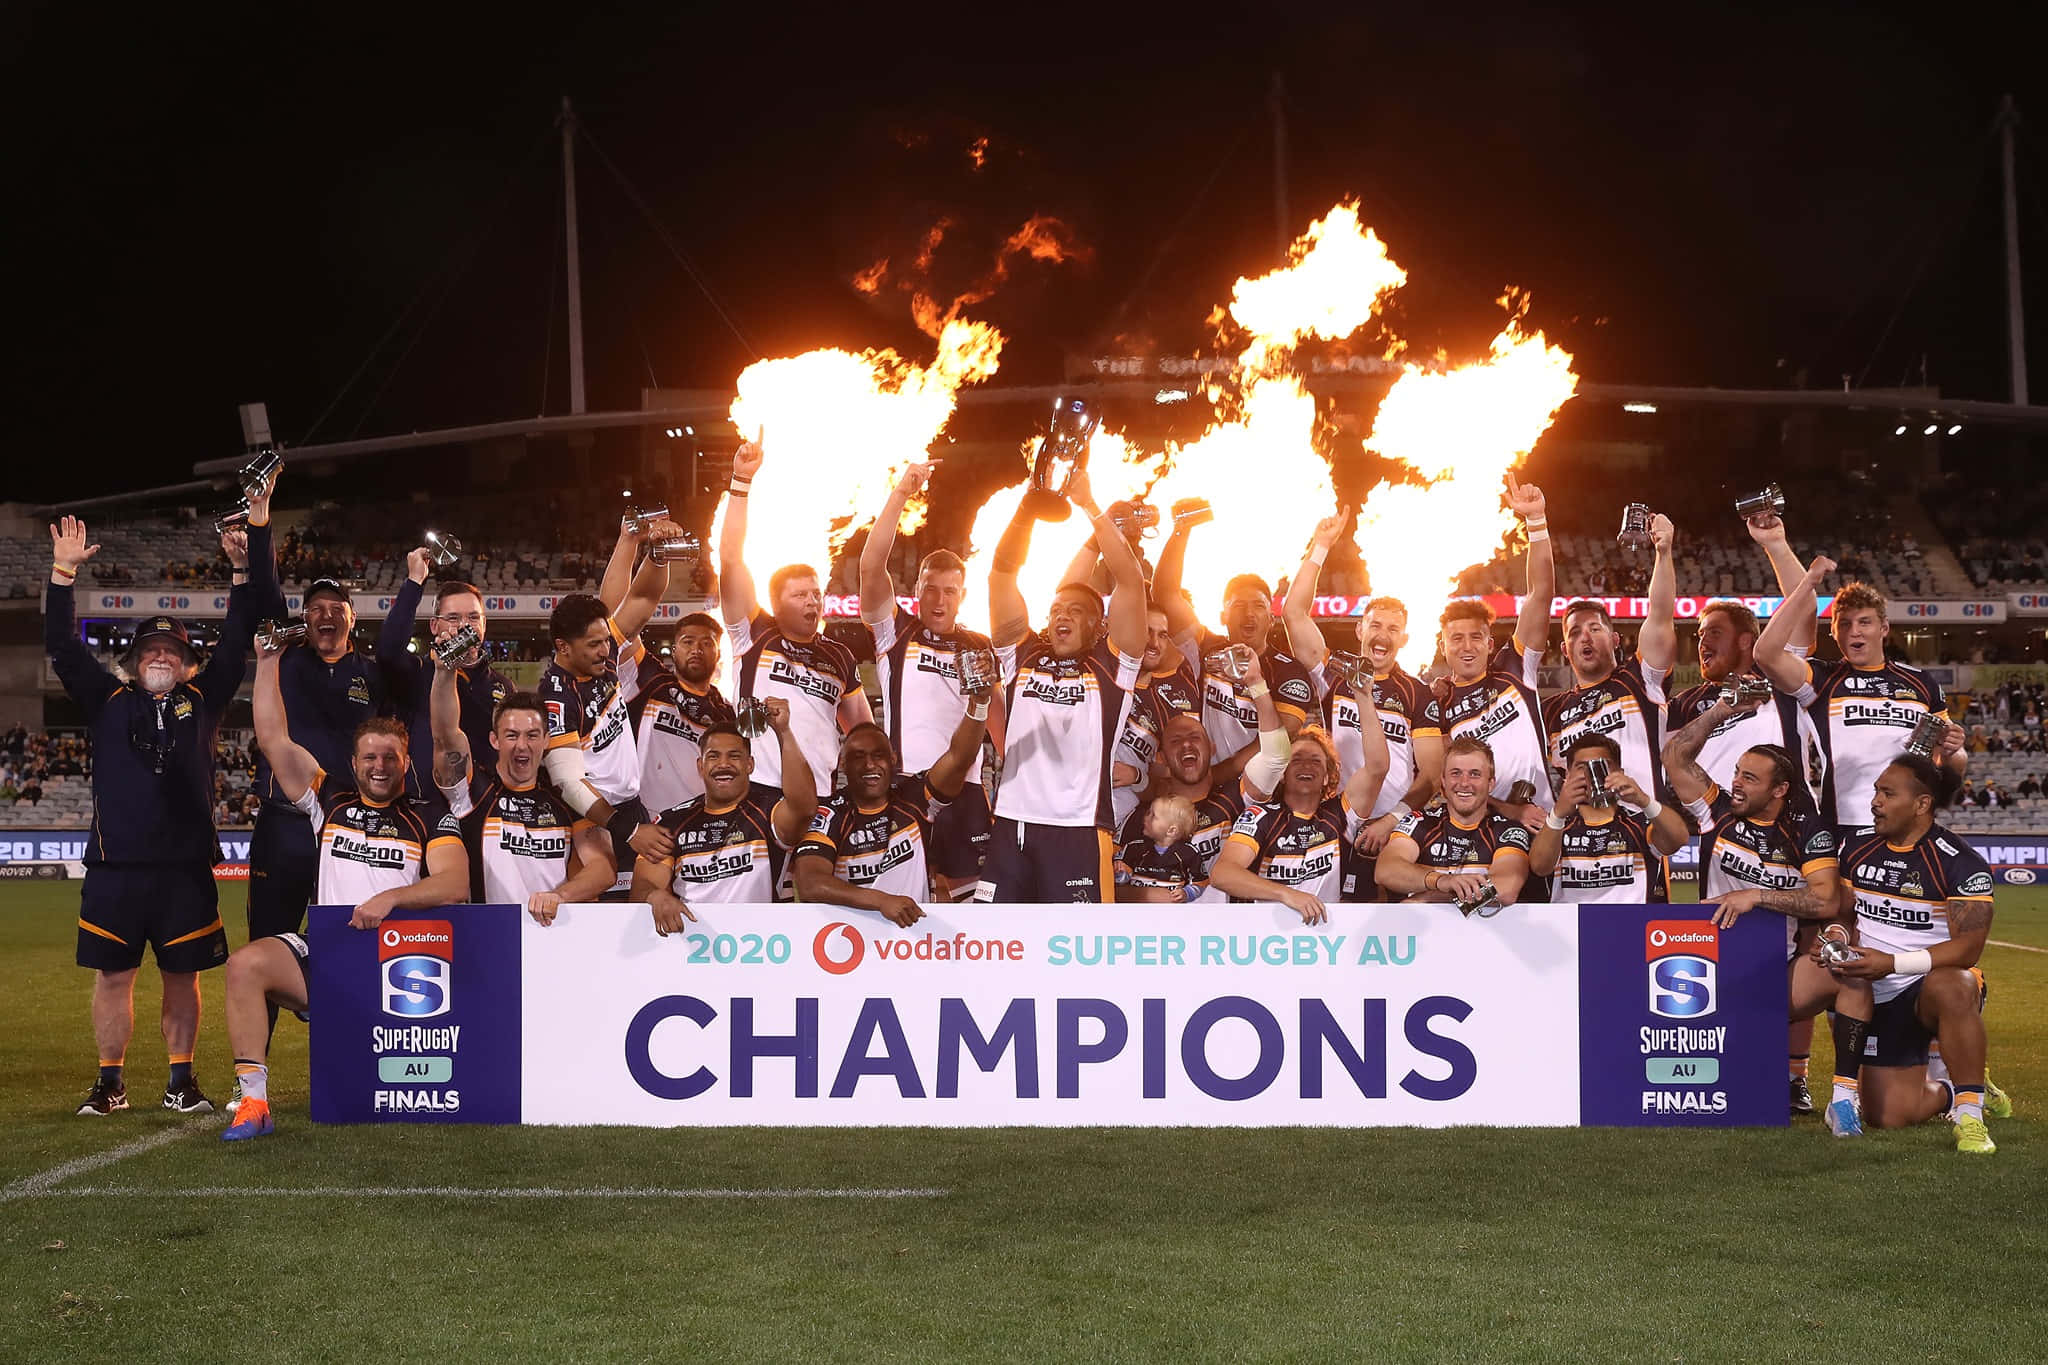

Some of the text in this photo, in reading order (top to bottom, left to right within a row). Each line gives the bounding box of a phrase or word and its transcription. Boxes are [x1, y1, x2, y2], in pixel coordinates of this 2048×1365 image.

[102, 595, 134, 609] GIO
[158, 595, 190, 609] GIO
[485, 597, 516, 610] GIO
[1315, 597, 1347, 616] TO
[1907, 604, 1938, 617] GIO
[1962, 604, 1993, 617] GIO
[681, 852, 752, 877] Plus500
[1721, 852, 1798, 888] Plus500
[1857, 898, 1930, 923] Plus500
[402, 932, 449, 943] vodafone
[1669, 932, 1715, 943] vodafone
[687, 933, 1416, 966] 2020 vodafone SUPER RUGBY AU
[626, 995, 1478, 1101] CHAMPIONS
[404, 1063, 430, 1076] AU
[1672, 1063, 1696, 1077] AU
[374, 1090, 460, 1113] FINALS
[1642, 1091, 1728, 1115] FINALS
